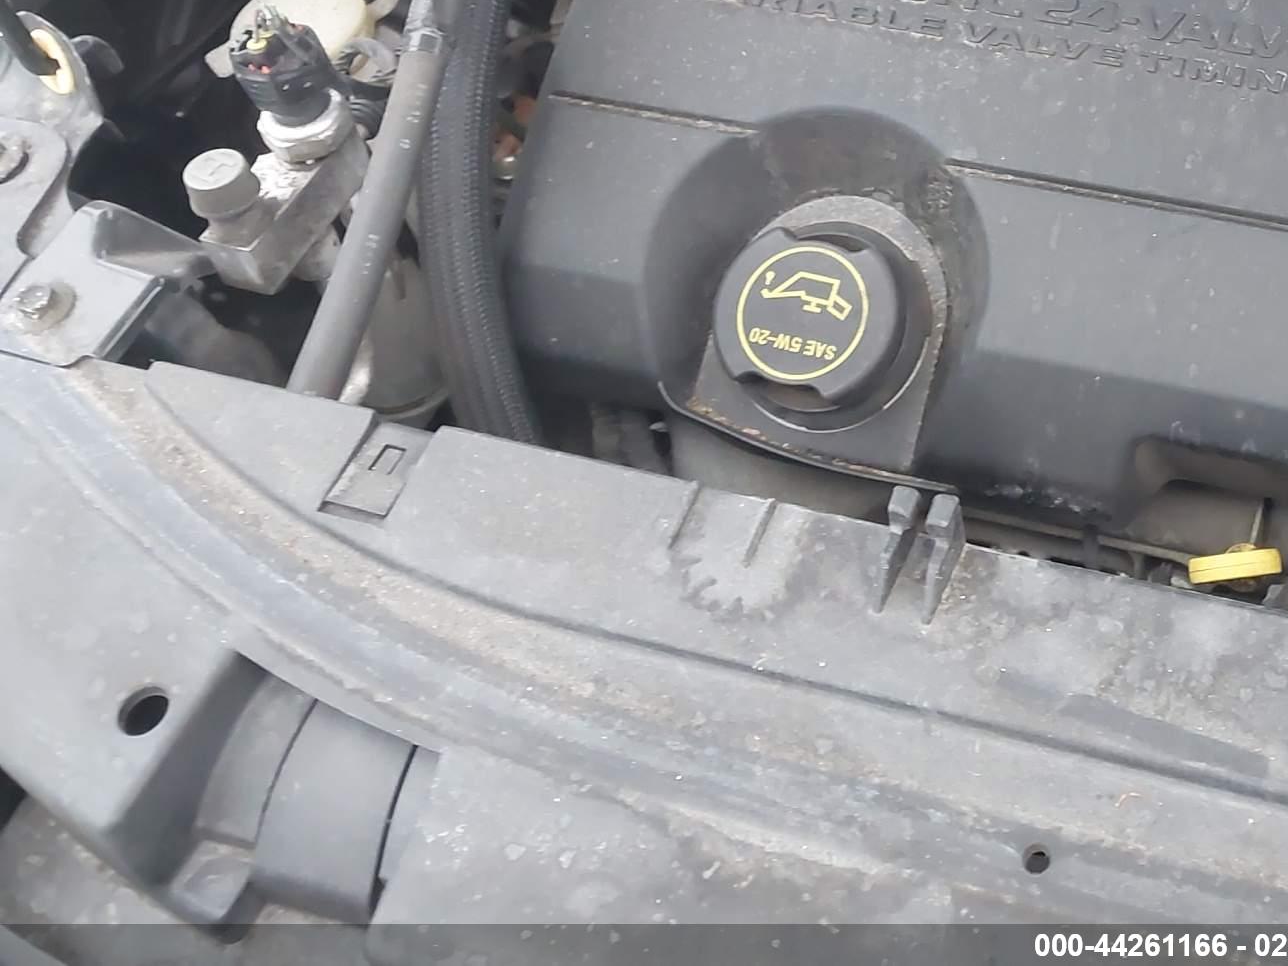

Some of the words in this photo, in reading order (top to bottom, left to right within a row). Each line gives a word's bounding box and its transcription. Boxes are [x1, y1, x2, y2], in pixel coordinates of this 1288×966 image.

[962, 19, 1127, 68] VALVE
[749, 327, 803, 353] 5W-20
[803, 340, 838, 360] SAE
